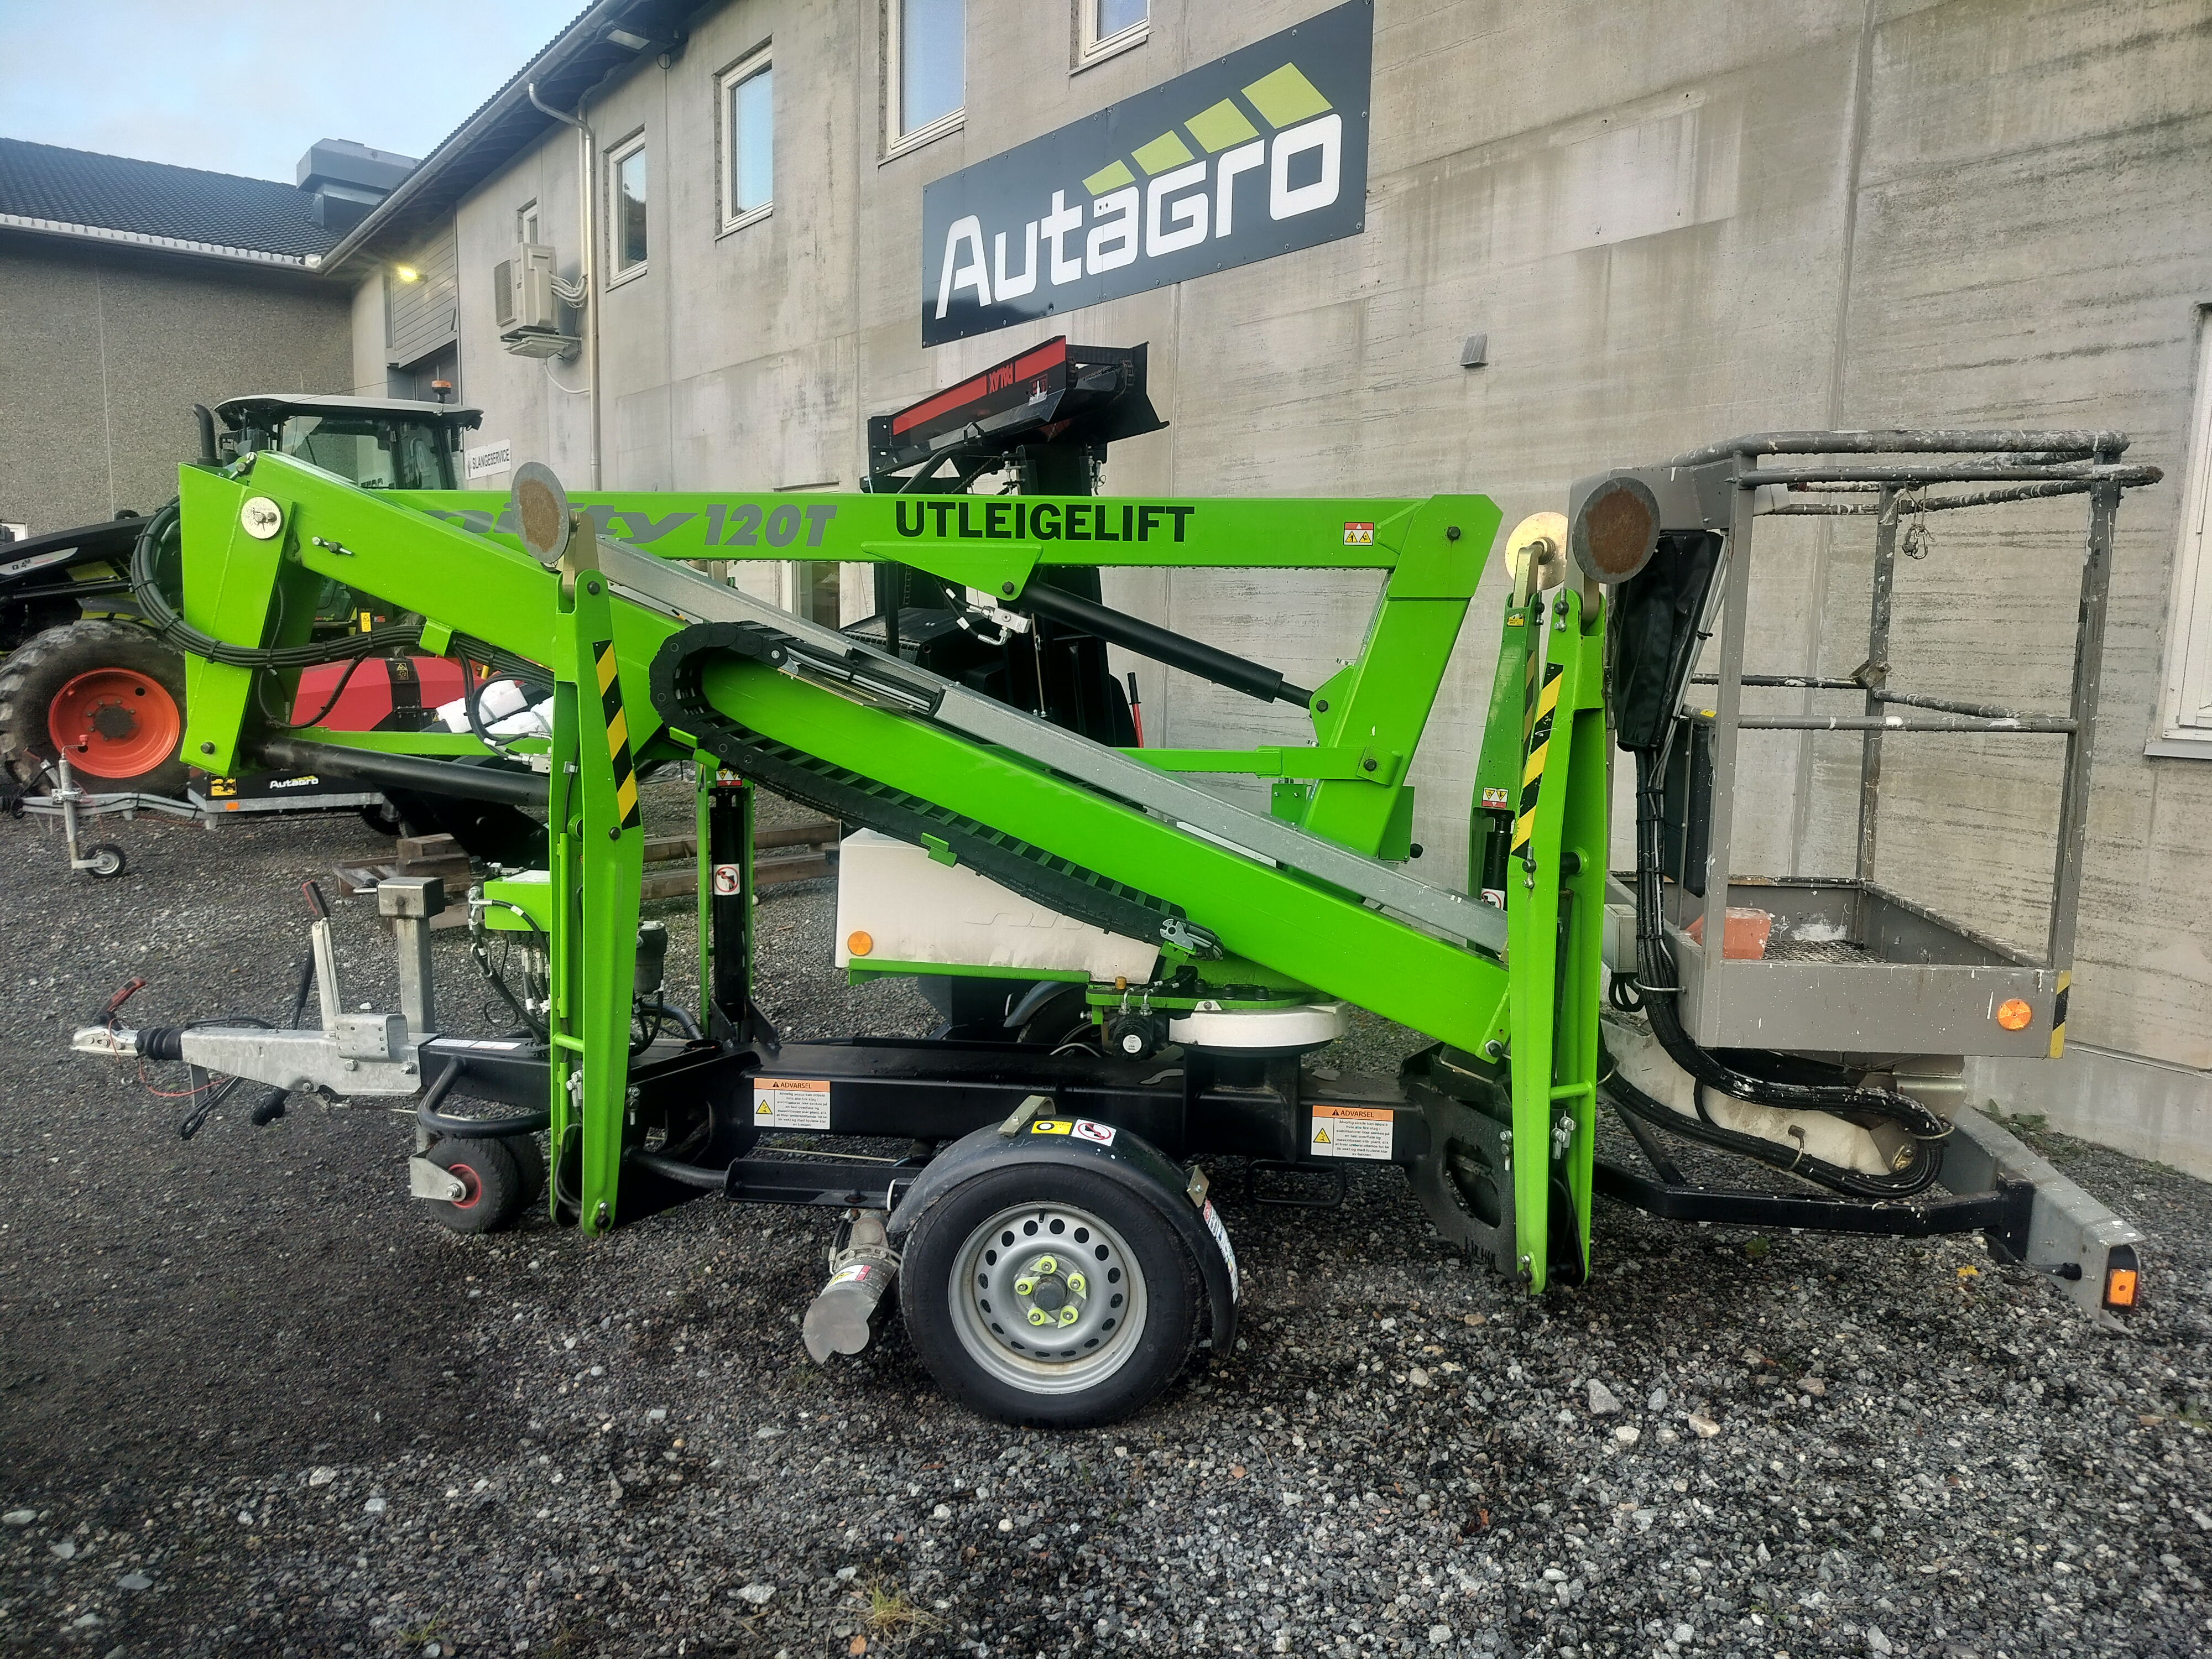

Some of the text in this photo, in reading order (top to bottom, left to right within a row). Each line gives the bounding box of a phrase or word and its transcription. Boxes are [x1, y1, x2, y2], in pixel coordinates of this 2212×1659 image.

[472, 448, 509, 469] SLANGESERVICE
[705, 504, 838, 547] 120T
[895, 500, 1194, 542] UTLEIGELIFT
